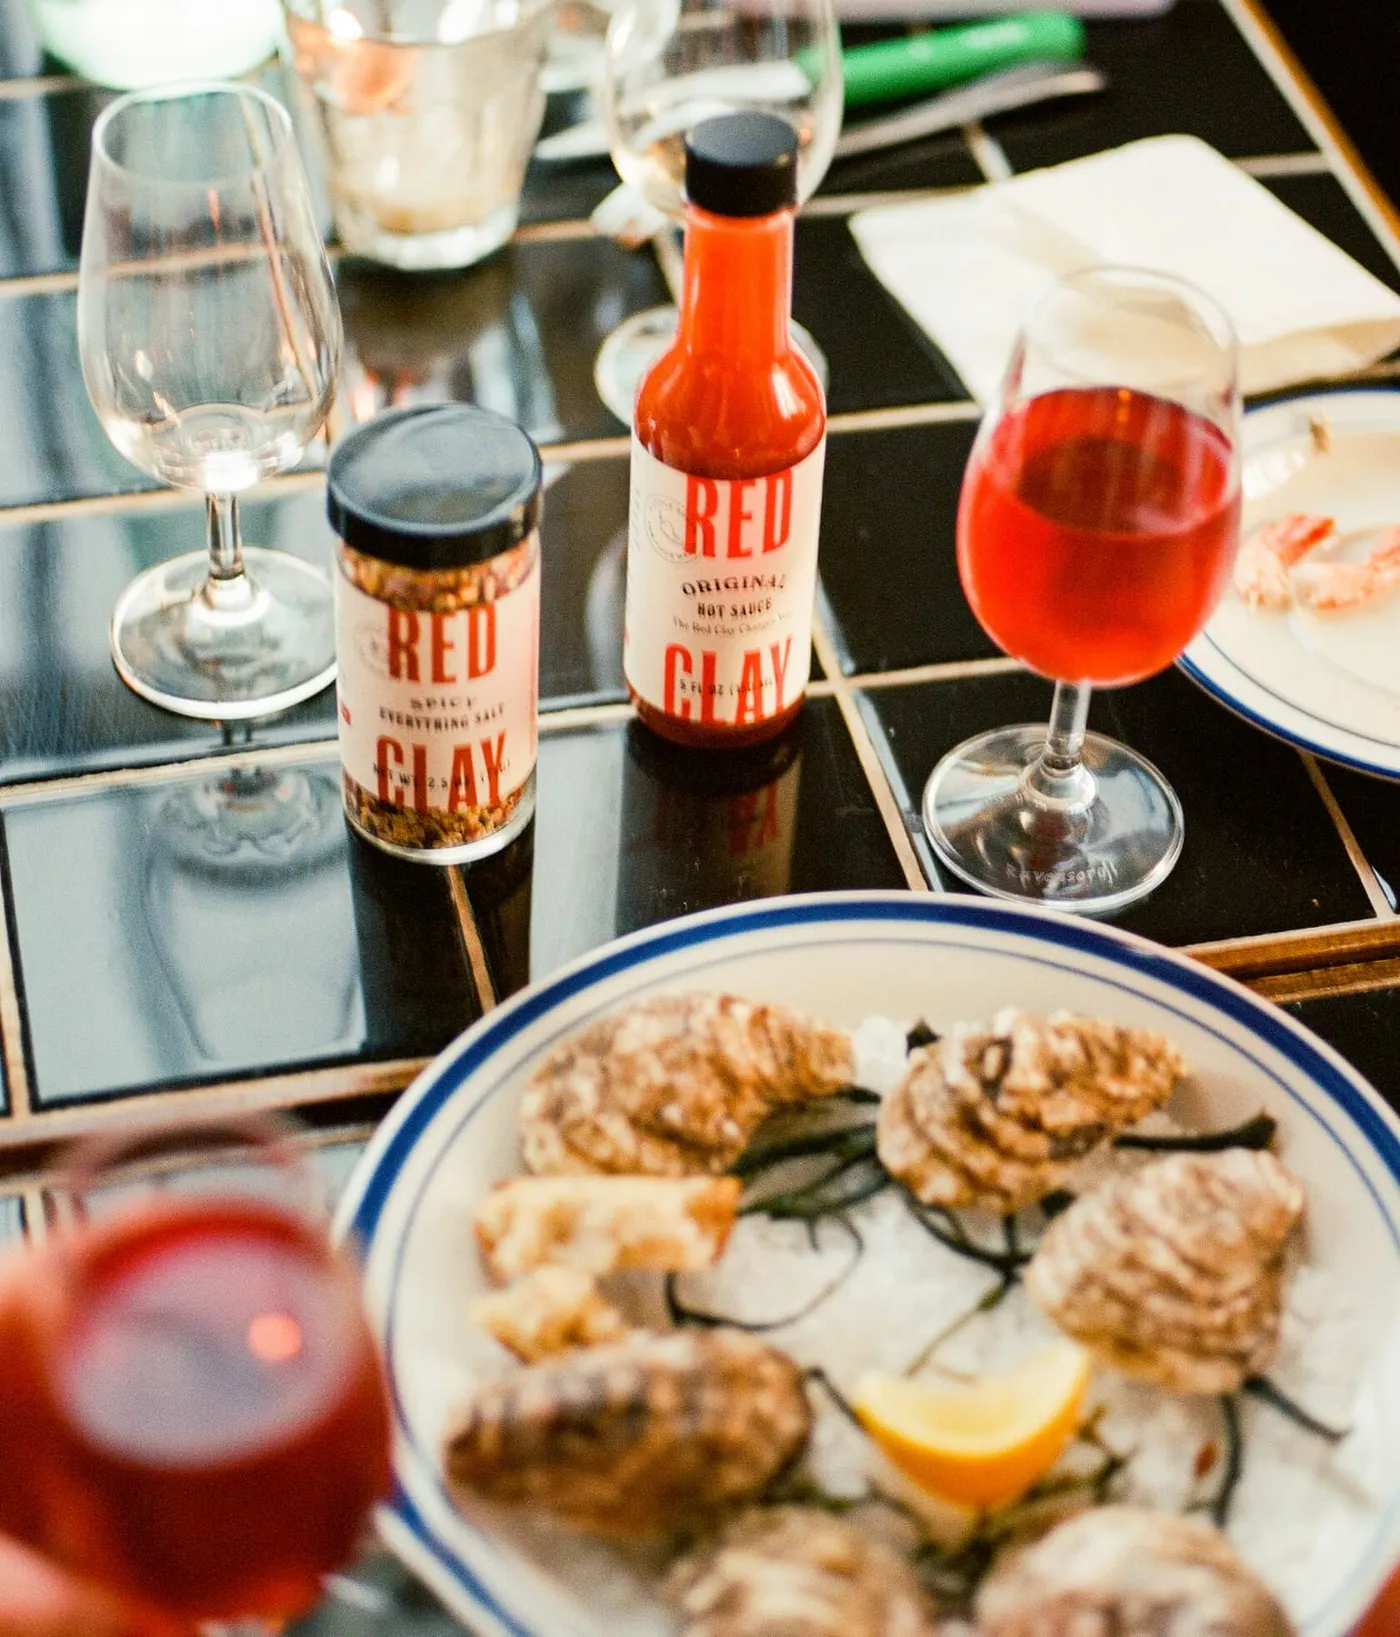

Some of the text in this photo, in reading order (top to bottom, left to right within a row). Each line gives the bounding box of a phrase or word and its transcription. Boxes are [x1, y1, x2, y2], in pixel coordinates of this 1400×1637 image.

[683, 468, 793, 559] RED
[682, 574, 786, 596] ORIGINAL
[697, 602, 724, 619] HOT
[730, 597, 772, 617] SAUCE
[388, 602, 497, 684] RED
[410, 697, 477, 710] SPICY
[664, 633, 793, 726] CLAY
[380, 701, 504, 731] EVERYTHING SALT
[376, 728, 506, 814] CLAY
